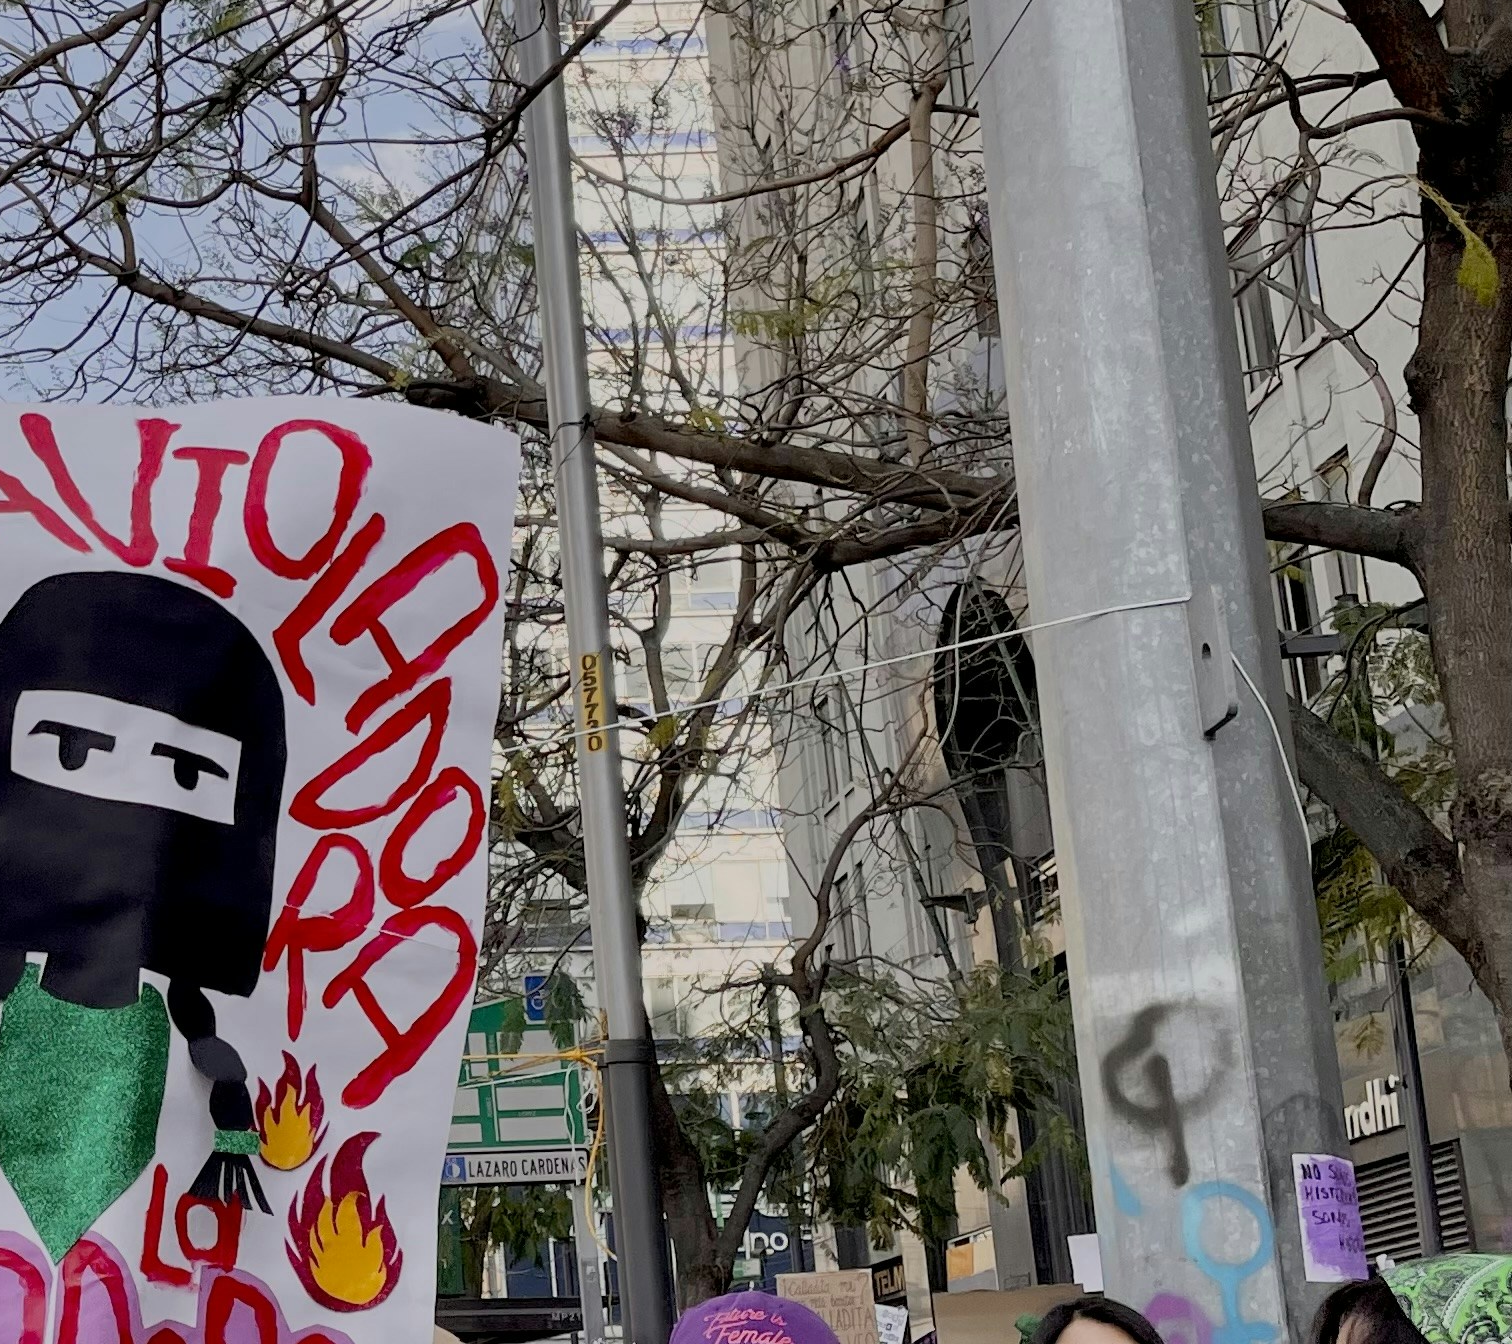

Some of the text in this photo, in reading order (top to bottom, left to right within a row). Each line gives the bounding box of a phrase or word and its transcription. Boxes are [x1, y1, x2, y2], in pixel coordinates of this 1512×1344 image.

[20, 413, 498, 1109] VIOLADORA
[468, 1161, 517, 1178] LAZARO
[1300, 1164, 1321, 1180] NO
